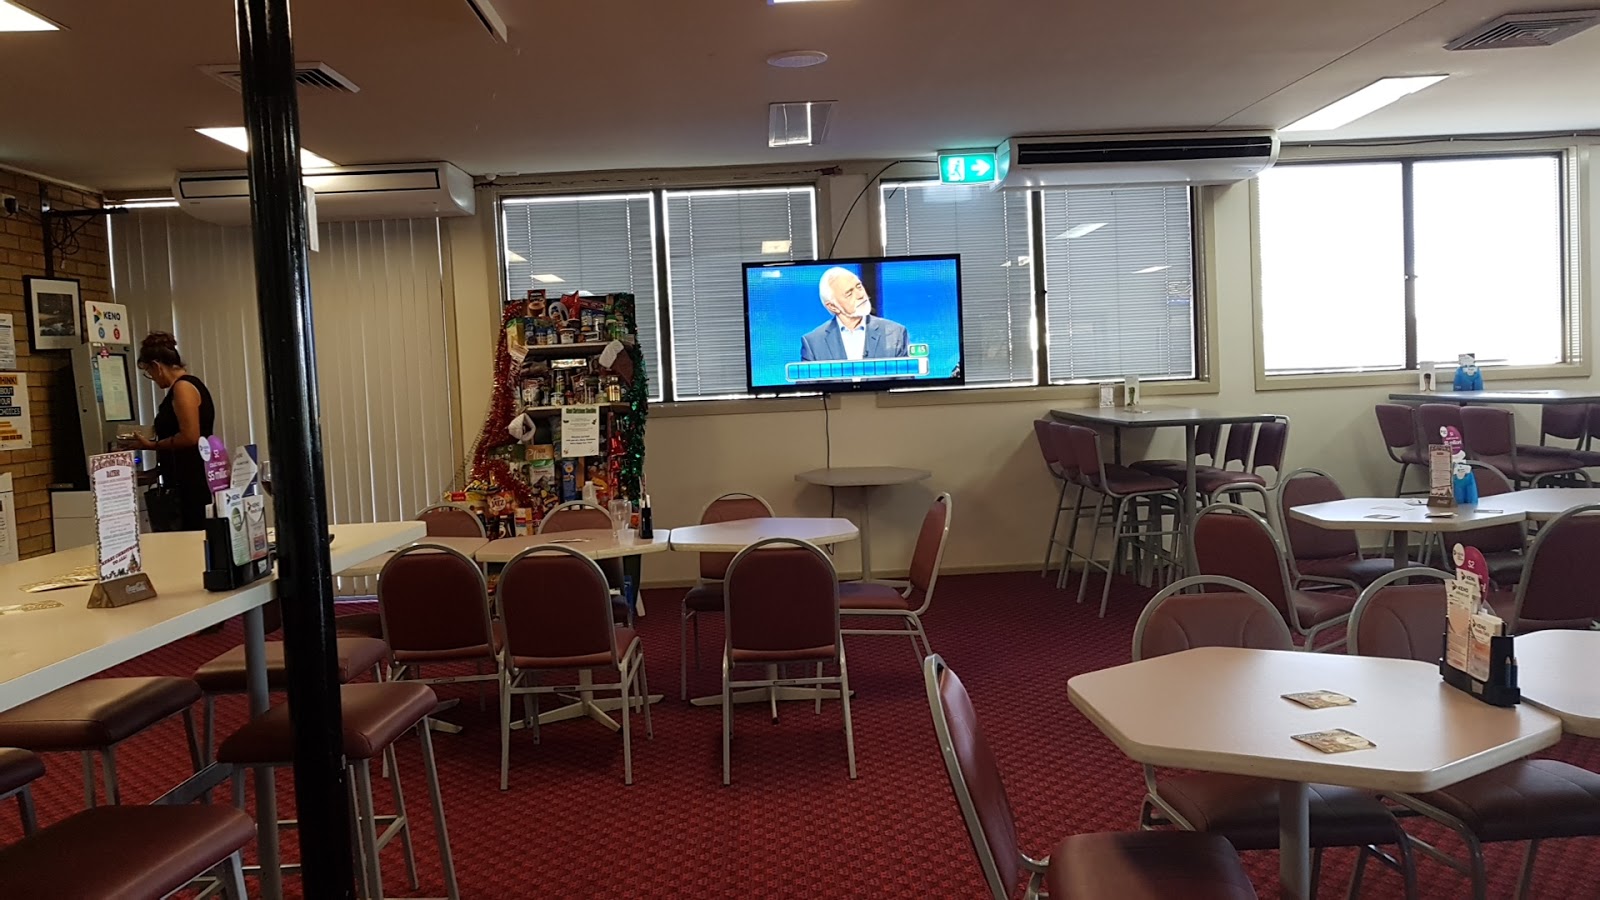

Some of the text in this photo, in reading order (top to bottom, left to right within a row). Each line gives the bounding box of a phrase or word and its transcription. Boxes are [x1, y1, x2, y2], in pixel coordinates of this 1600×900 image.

[103, 311, 121, 321] KENO
[0, 376, 17, 385] HINK!
[0, 388, 14, 396] BOUT
